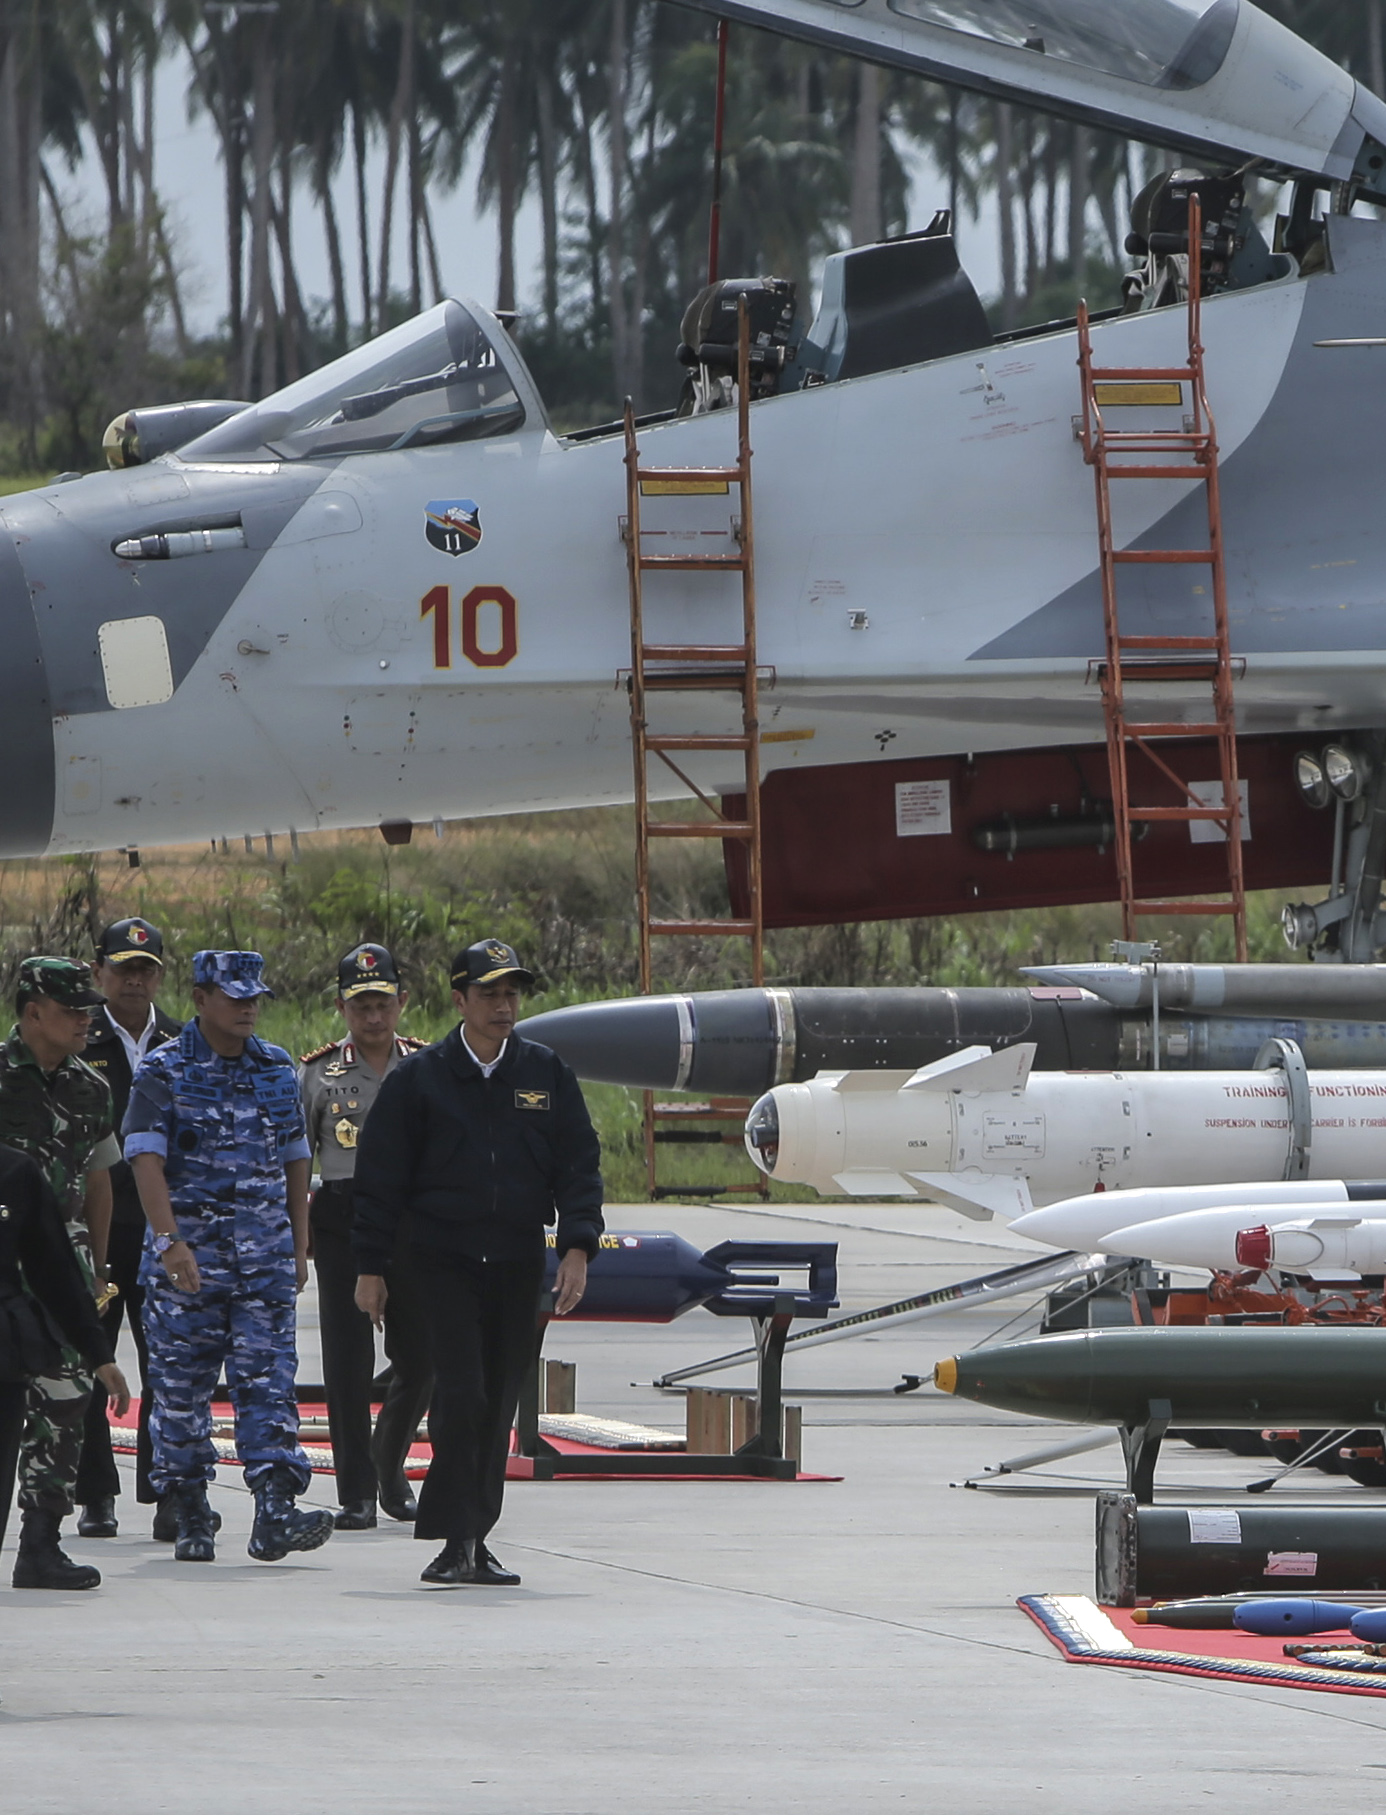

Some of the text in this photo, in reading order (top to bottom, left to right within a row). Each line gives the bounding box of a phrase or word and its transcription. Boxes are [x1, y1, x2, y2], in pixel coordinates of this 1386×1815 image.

[444, 533, 462, 551] 11
[420, 584, 518, 670] 10
[259, 1087, 295, 1099] TNI AU
[325, 1086, 359, 1097] TITO
[1222, 1085, 1288, 1097] TRAINING
[1204, 1118, 1256, 1128] SUSPENSION
[1261, 1119, 1289, 1129] UNDER
[1347, 1117, 1357, 1127] IS
